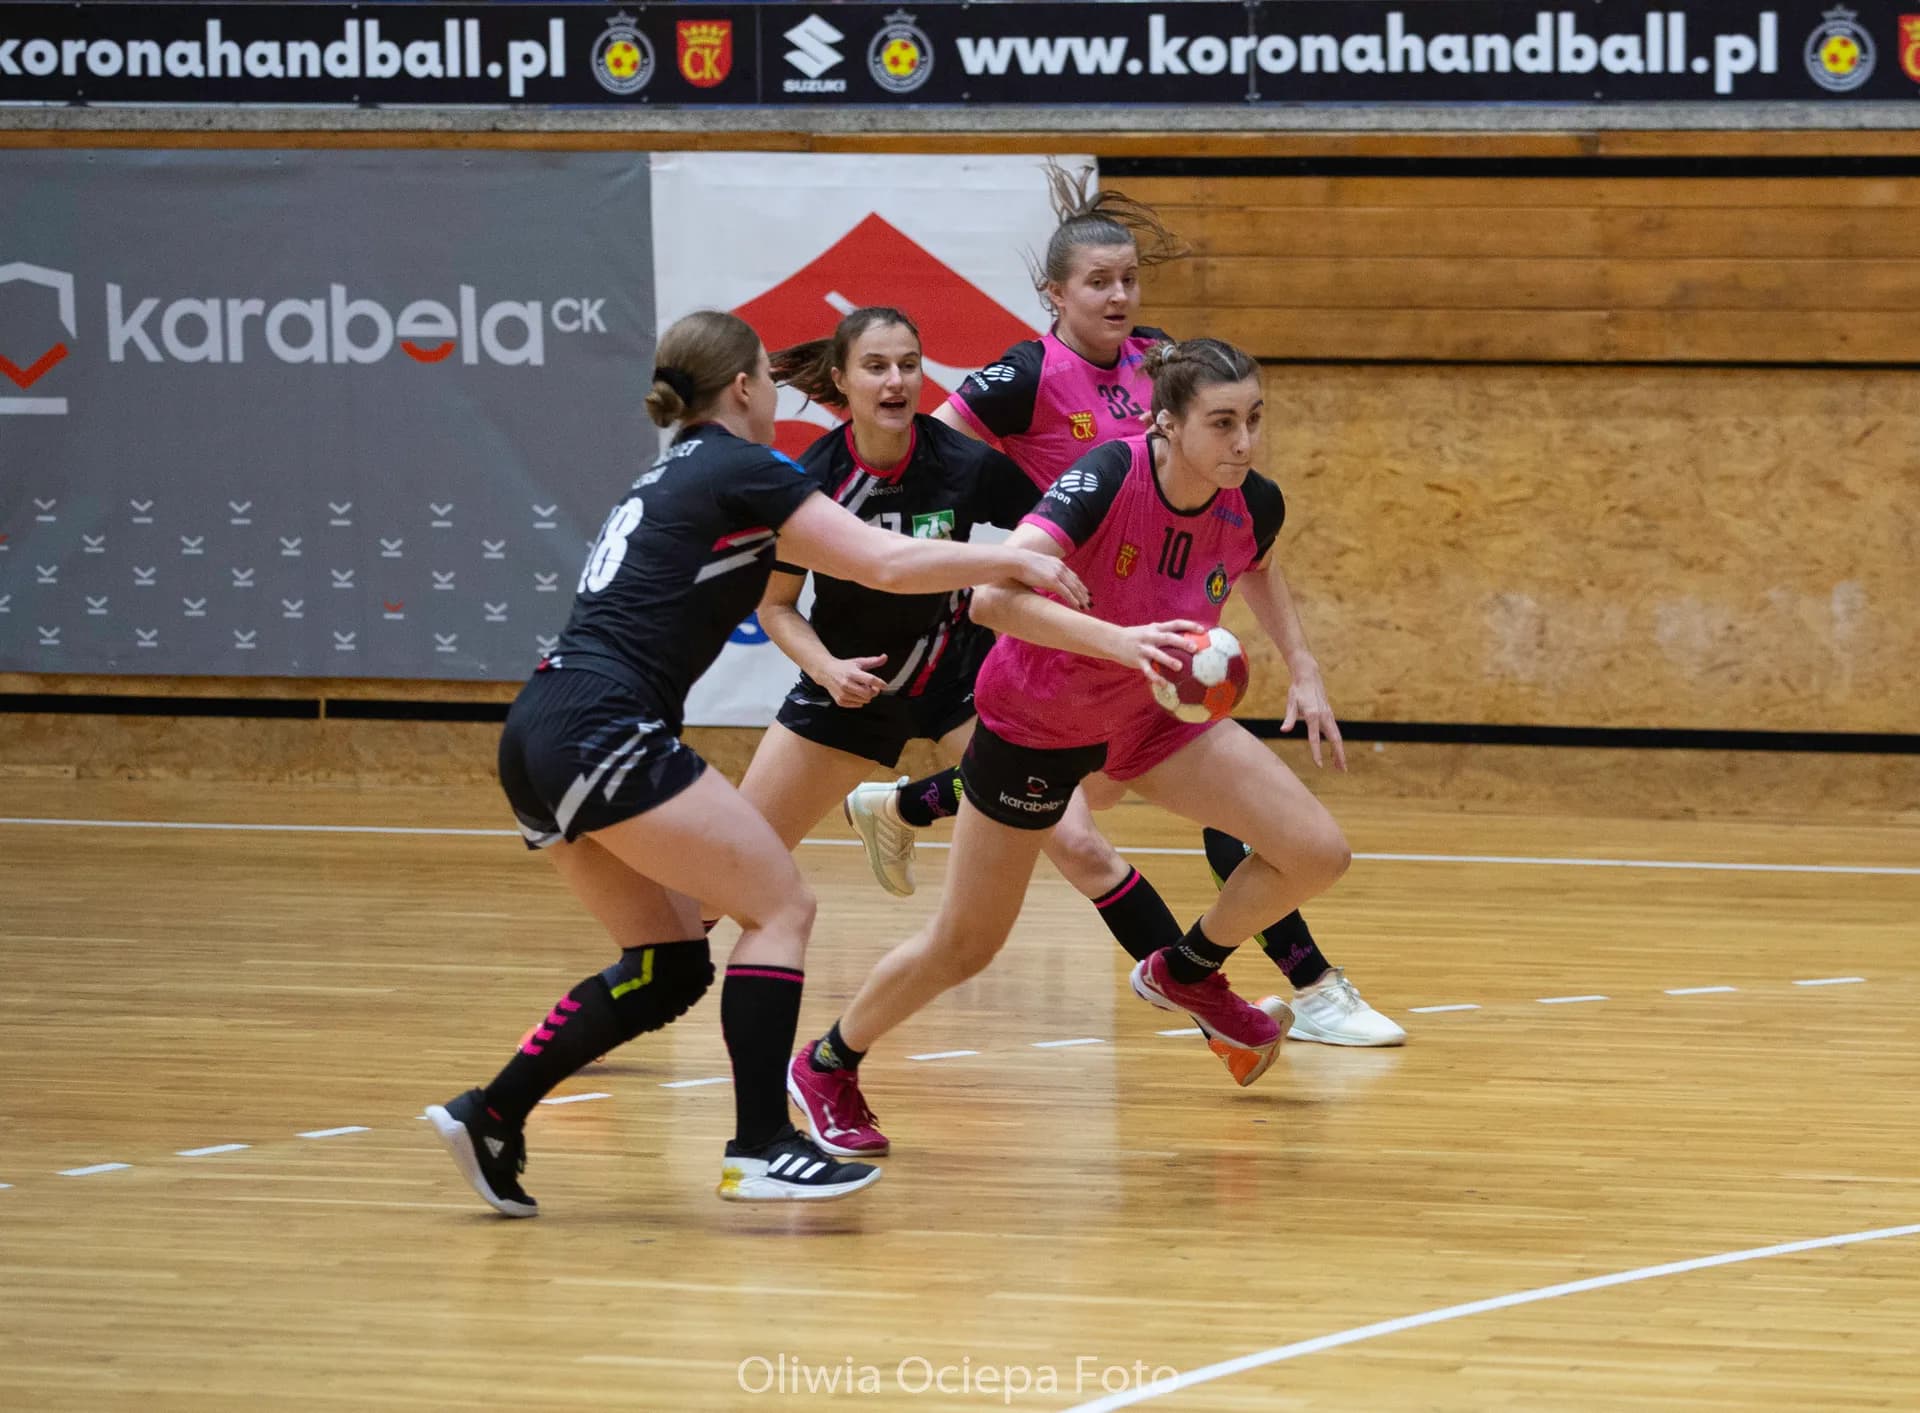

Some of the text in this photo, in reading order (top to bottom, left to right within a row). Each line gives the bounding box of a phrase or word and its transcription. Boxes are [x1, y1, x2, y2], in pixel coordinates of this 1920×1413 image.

[683, 47, 721, 80] CK
[956, 11, 1778, 94] www.koronahandball.pl
[783, 79, 847, 92] SUZUKI
[106, 283, 607, 366] karabela CK
[1097, 384, 1145, 420] 32
[1072, 422, 1095, 439] CK
[1157, 526, 1194, 581] 10
